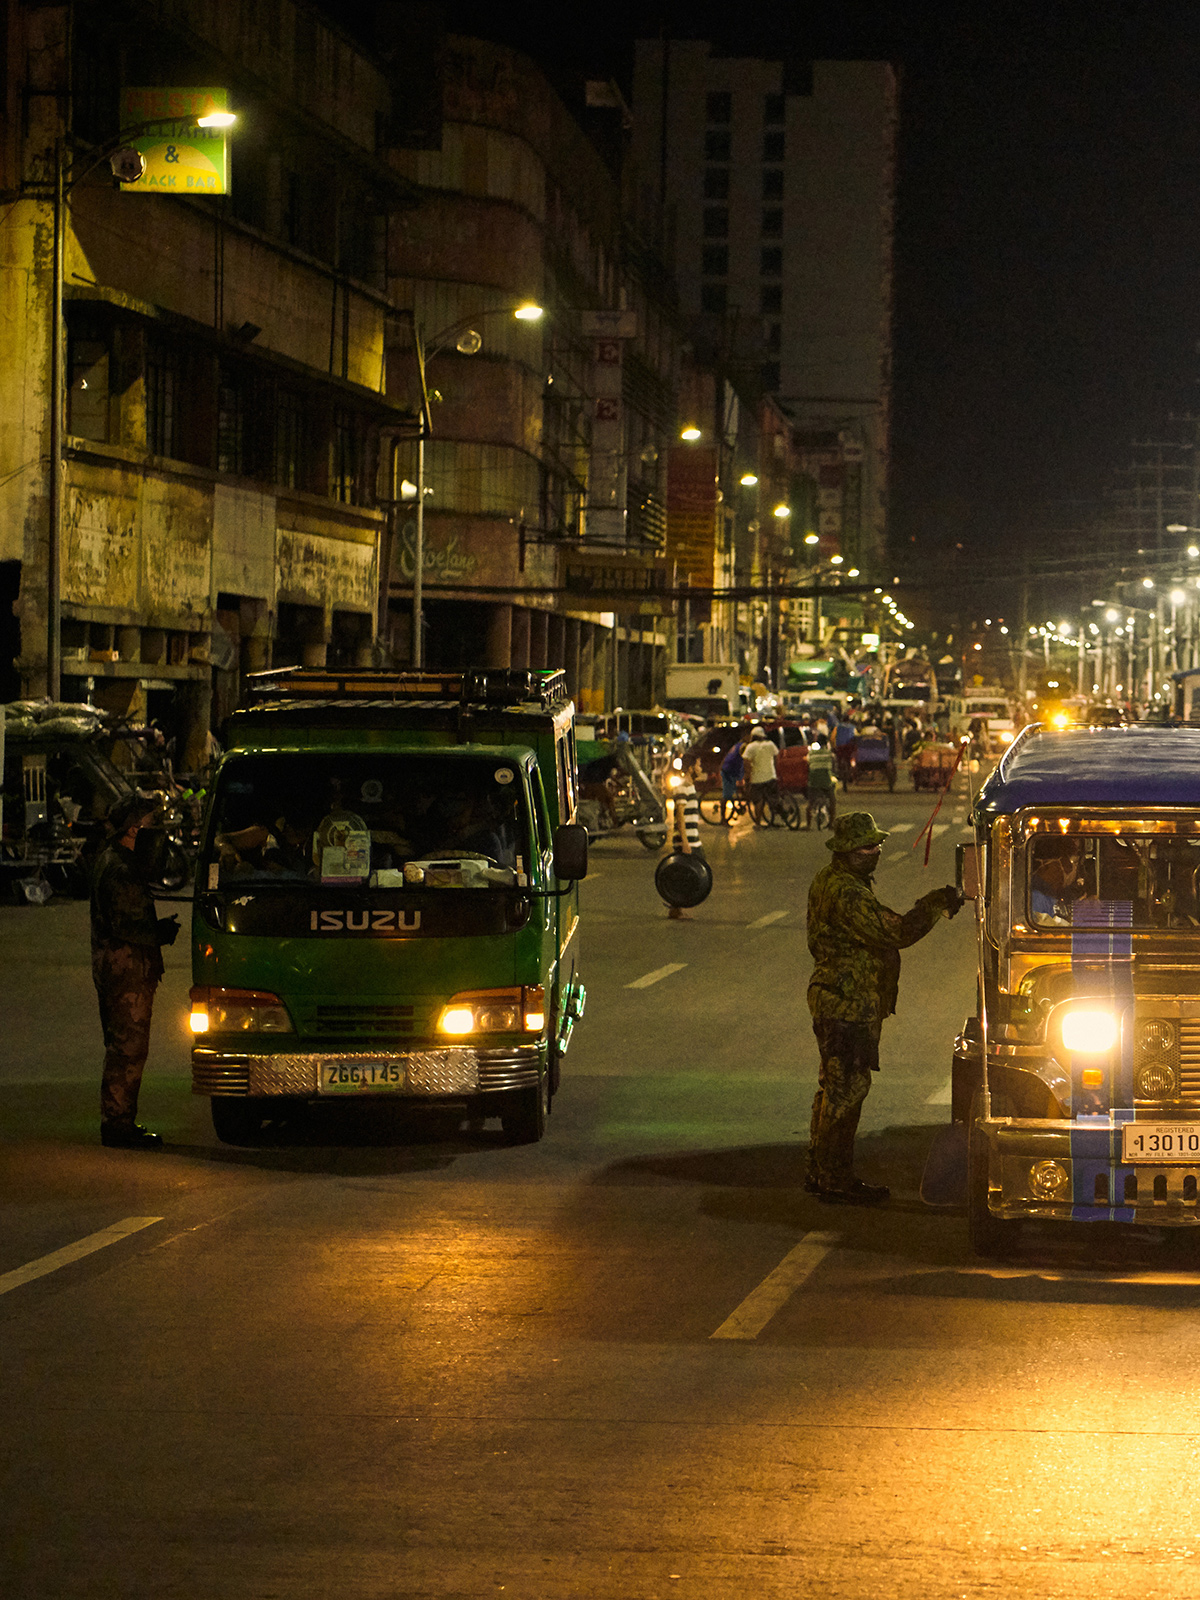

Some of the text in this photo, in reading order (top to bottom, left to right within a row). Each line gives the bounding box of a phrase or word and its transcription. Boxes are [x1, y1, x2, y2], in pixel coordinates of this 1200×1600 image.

[165, 145, 179, 163] &
[138, 174, 217, 188] NACK BAR
[310, 910, 421, 931] ISUZU
